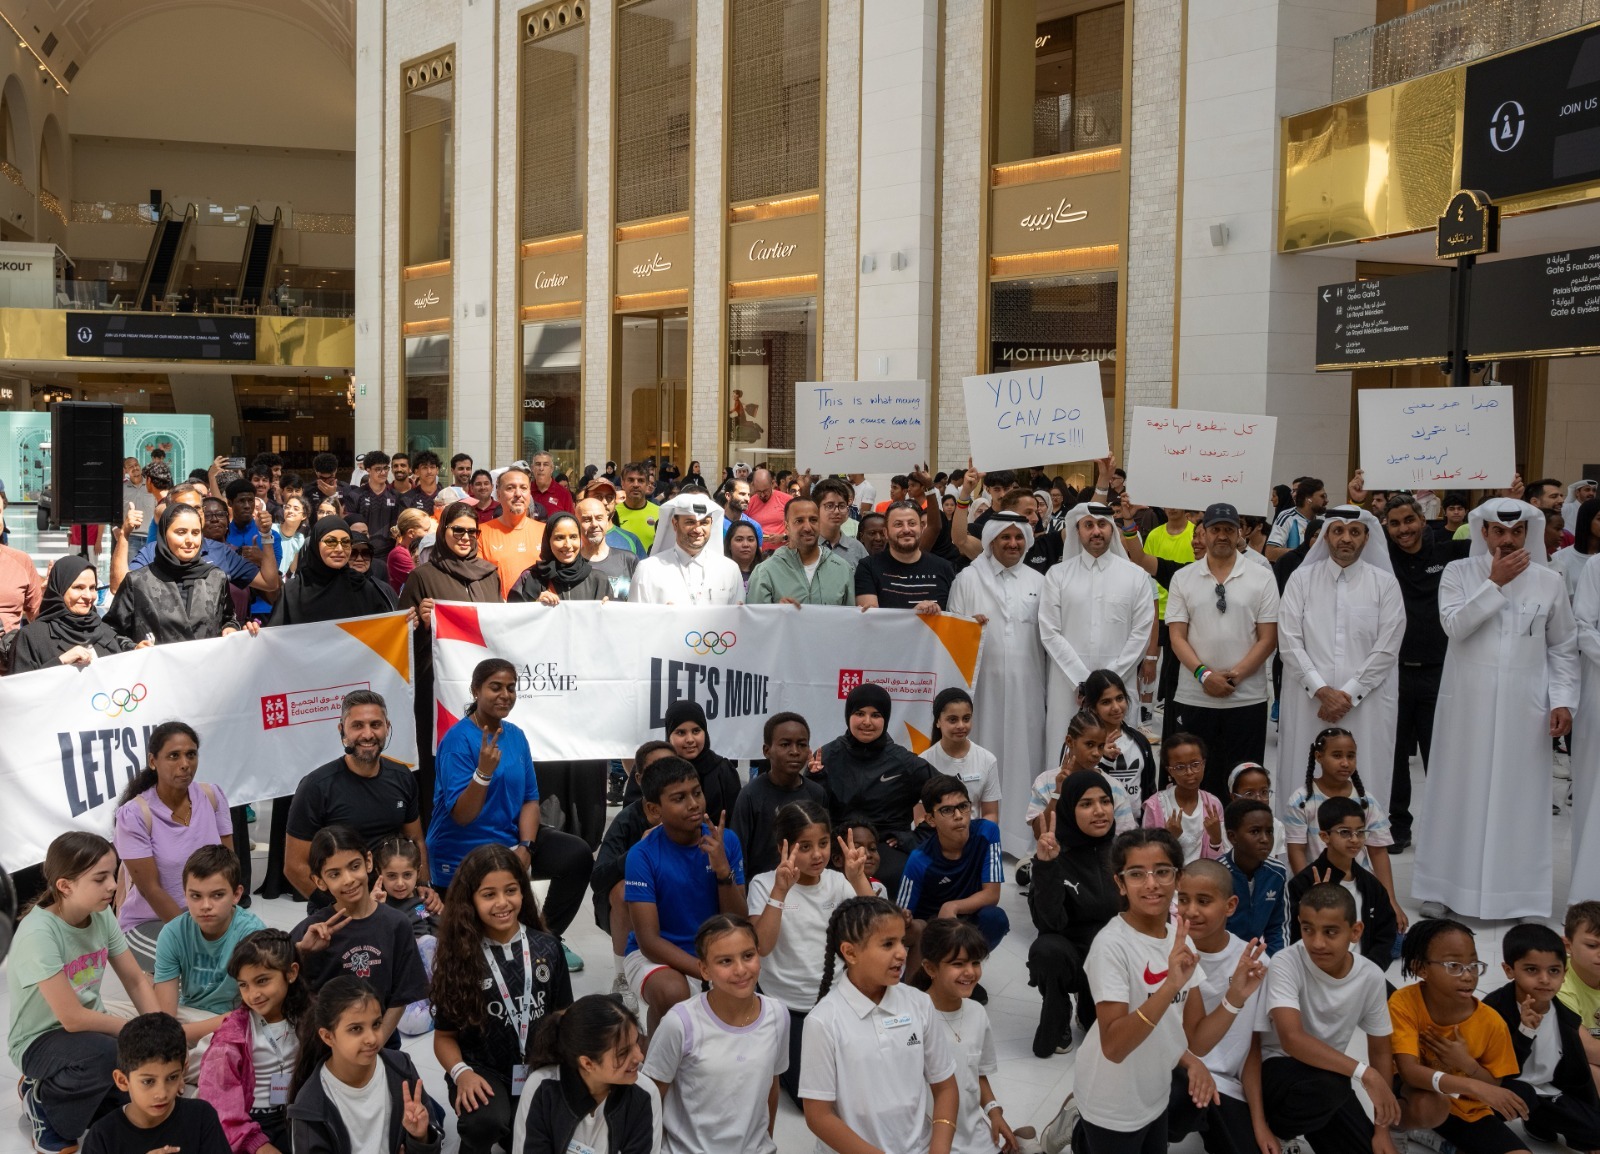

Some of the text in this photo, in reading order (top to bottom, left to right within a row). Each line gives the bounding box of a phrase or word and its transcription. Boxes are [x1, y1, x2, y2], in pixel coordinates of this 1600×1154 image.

[1559, 97, 1598, 117] JOIN US
[749, 239, 798, 261] Cartier
[0, 262, 33, 271] KOUT
[1546, 265, 1565, 275] Gate
[1566, 263, 1571, 272] 5
[535, 271, 568, 290] Cartier
[1362, 290, 1376, 299] Gate
[1376, 289, 1381, 297] 3
[1552, 287, 1571, 295] Palais
[1550, 307, 1569, 317] Gate
[1570, 306, 1576, 315] 6
[814, 388, 921, 410] This is what moving
[986, 375, 1045, 408] YOU
[818, 416, 839, 430] for
[860, 417, 886, 425] cause
[997, 407, 1081, 430] CAN DO
[1233, 423, 1258, 436] كل
[1020, 428, 1084, 449] THIS!!!!
[520, 662, 559, 677] ACE
[650, 657, 769, 729] LET'S MOVE
[899, 686, 923, 694] Above
[291, 706, 330, 716] Education
[57, 727, 140, 818] LET'S
